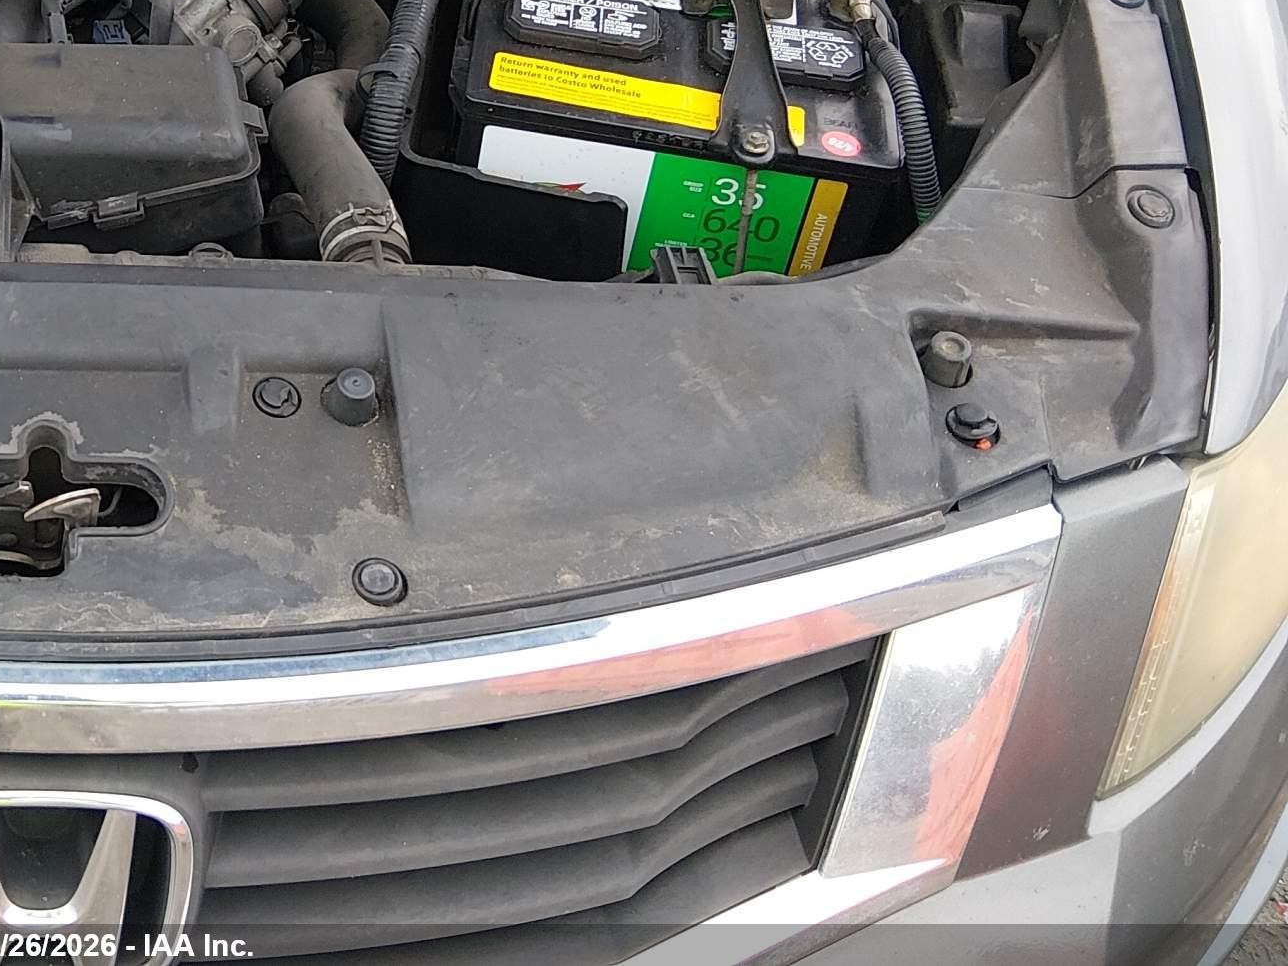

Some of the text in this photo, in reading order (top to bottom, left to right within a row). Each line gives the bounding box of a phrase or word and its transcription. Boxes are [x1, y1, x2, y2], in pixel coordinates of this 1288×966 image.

[596, 0, 639, 11] POISON
[499, 65, 641, 98] batteries to Costco Wholesale
[501, 56, 627, 86] Return warranty and used
[712, 178, 767, 210] 35
[703, 209, 780, 243] 640
[800, 213, 828, 271] AUTOMOTIVE
